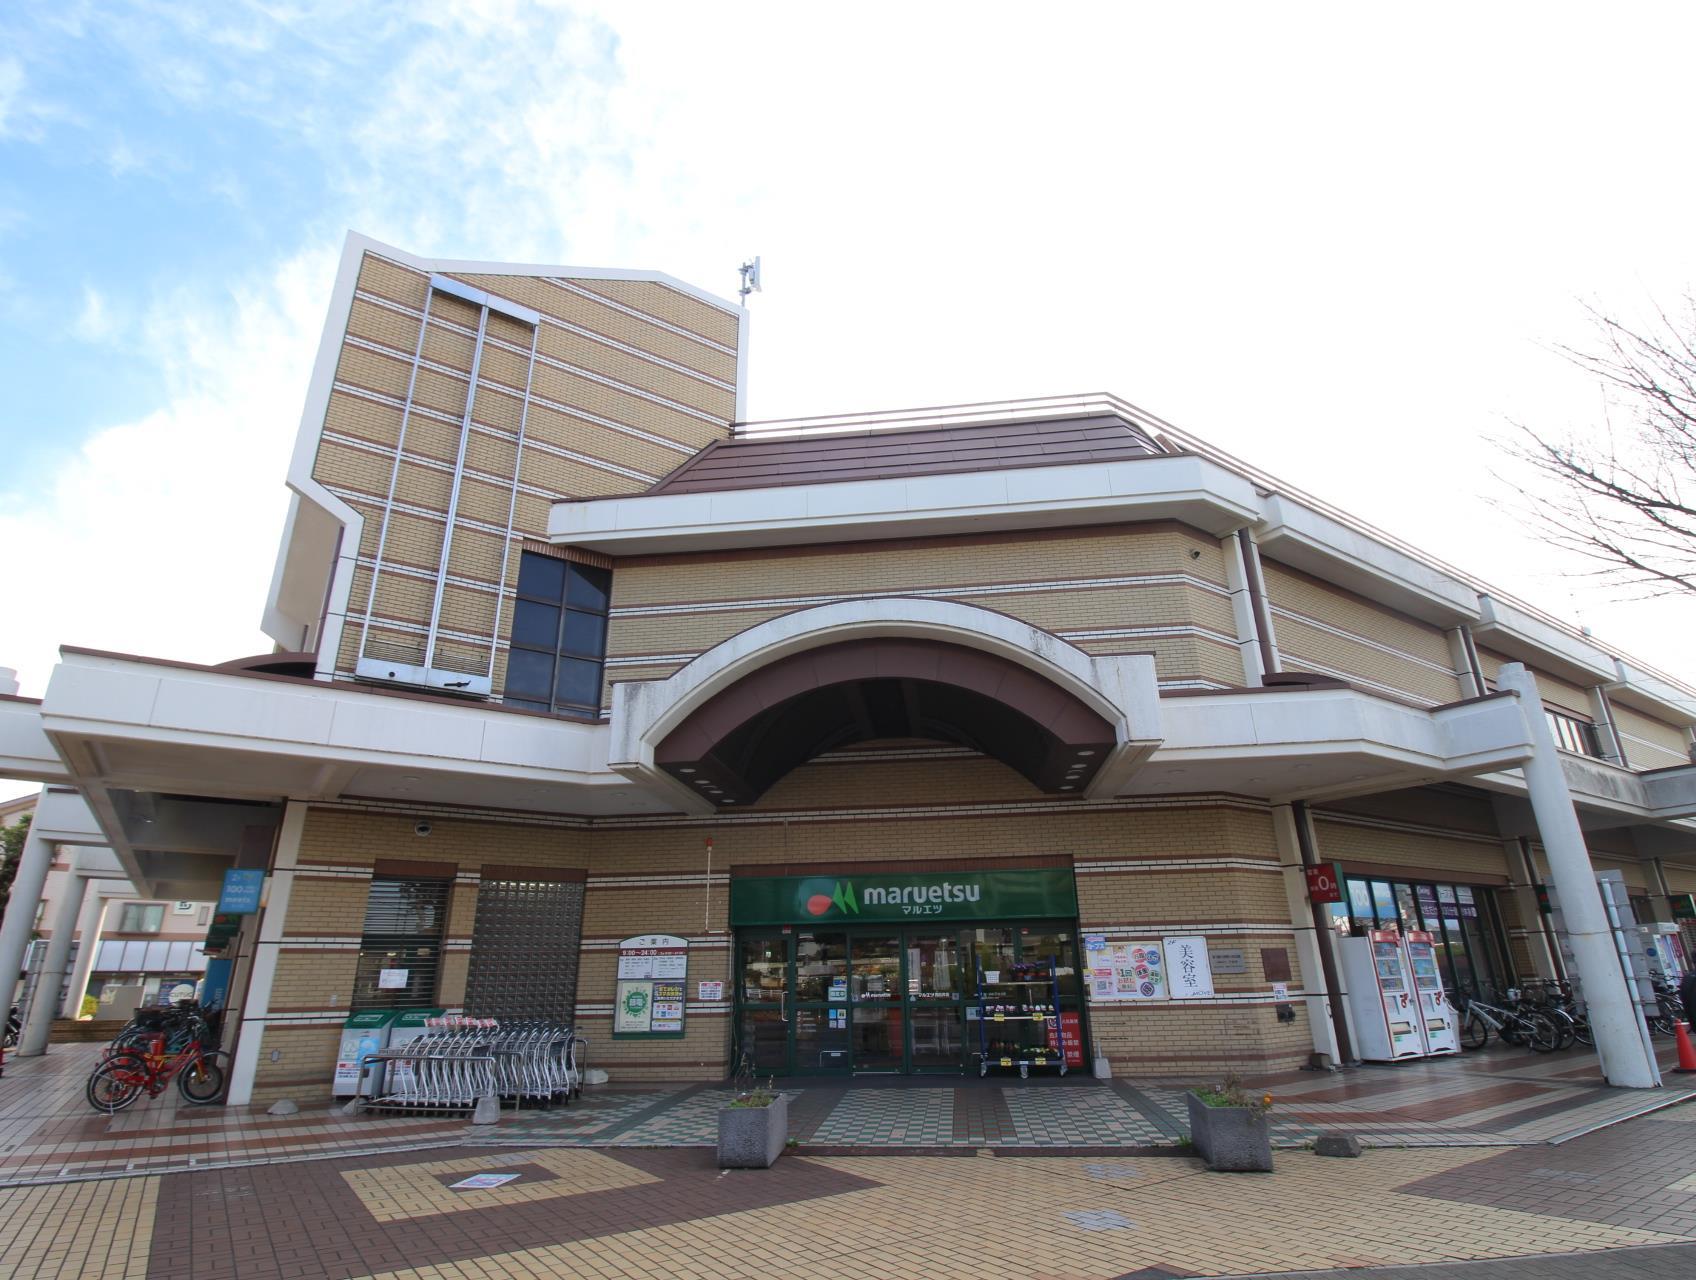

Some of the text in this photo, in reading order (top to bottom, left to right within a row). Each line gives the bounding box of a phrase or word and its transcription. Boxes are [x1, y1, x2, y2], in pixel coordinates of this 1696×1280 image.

[863, 882, 980, 905] maruetsu
[901, 905, 942, 916] マルエツ
[1179, 944, 1198, 988] 美容室
